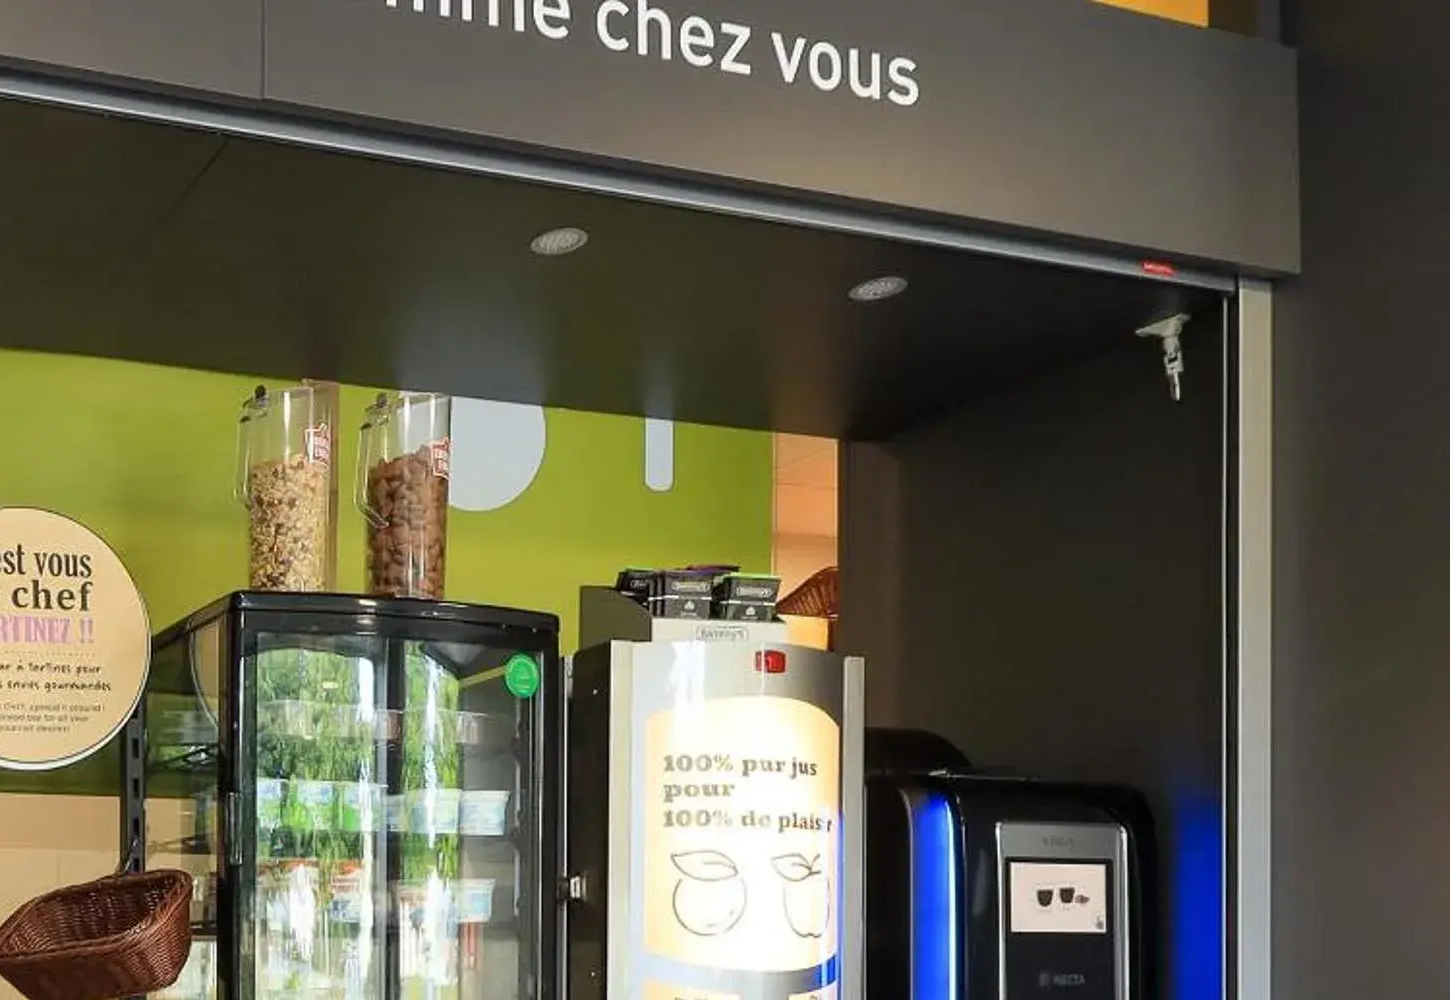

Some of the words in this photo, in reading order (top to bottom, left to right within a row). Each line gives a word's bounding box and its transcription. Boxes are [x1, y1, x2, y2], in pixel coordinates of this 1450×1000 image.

[596, 0, 751, 75] chez
[771, 32, 920, 106] vous
[34, 552, 92, 578] vous
[12, 579, 93, 611] chef
[76, 664, 101, 677] pour
[663, 754, 733, 773] 100%
[742, 757, 785, 777] pur
[790, 757, 817, 779] jus
[663, 784, 735, 803] pour
[663, 809, 733, 828] 100%
[778, 813, 832, 833] plaisr
